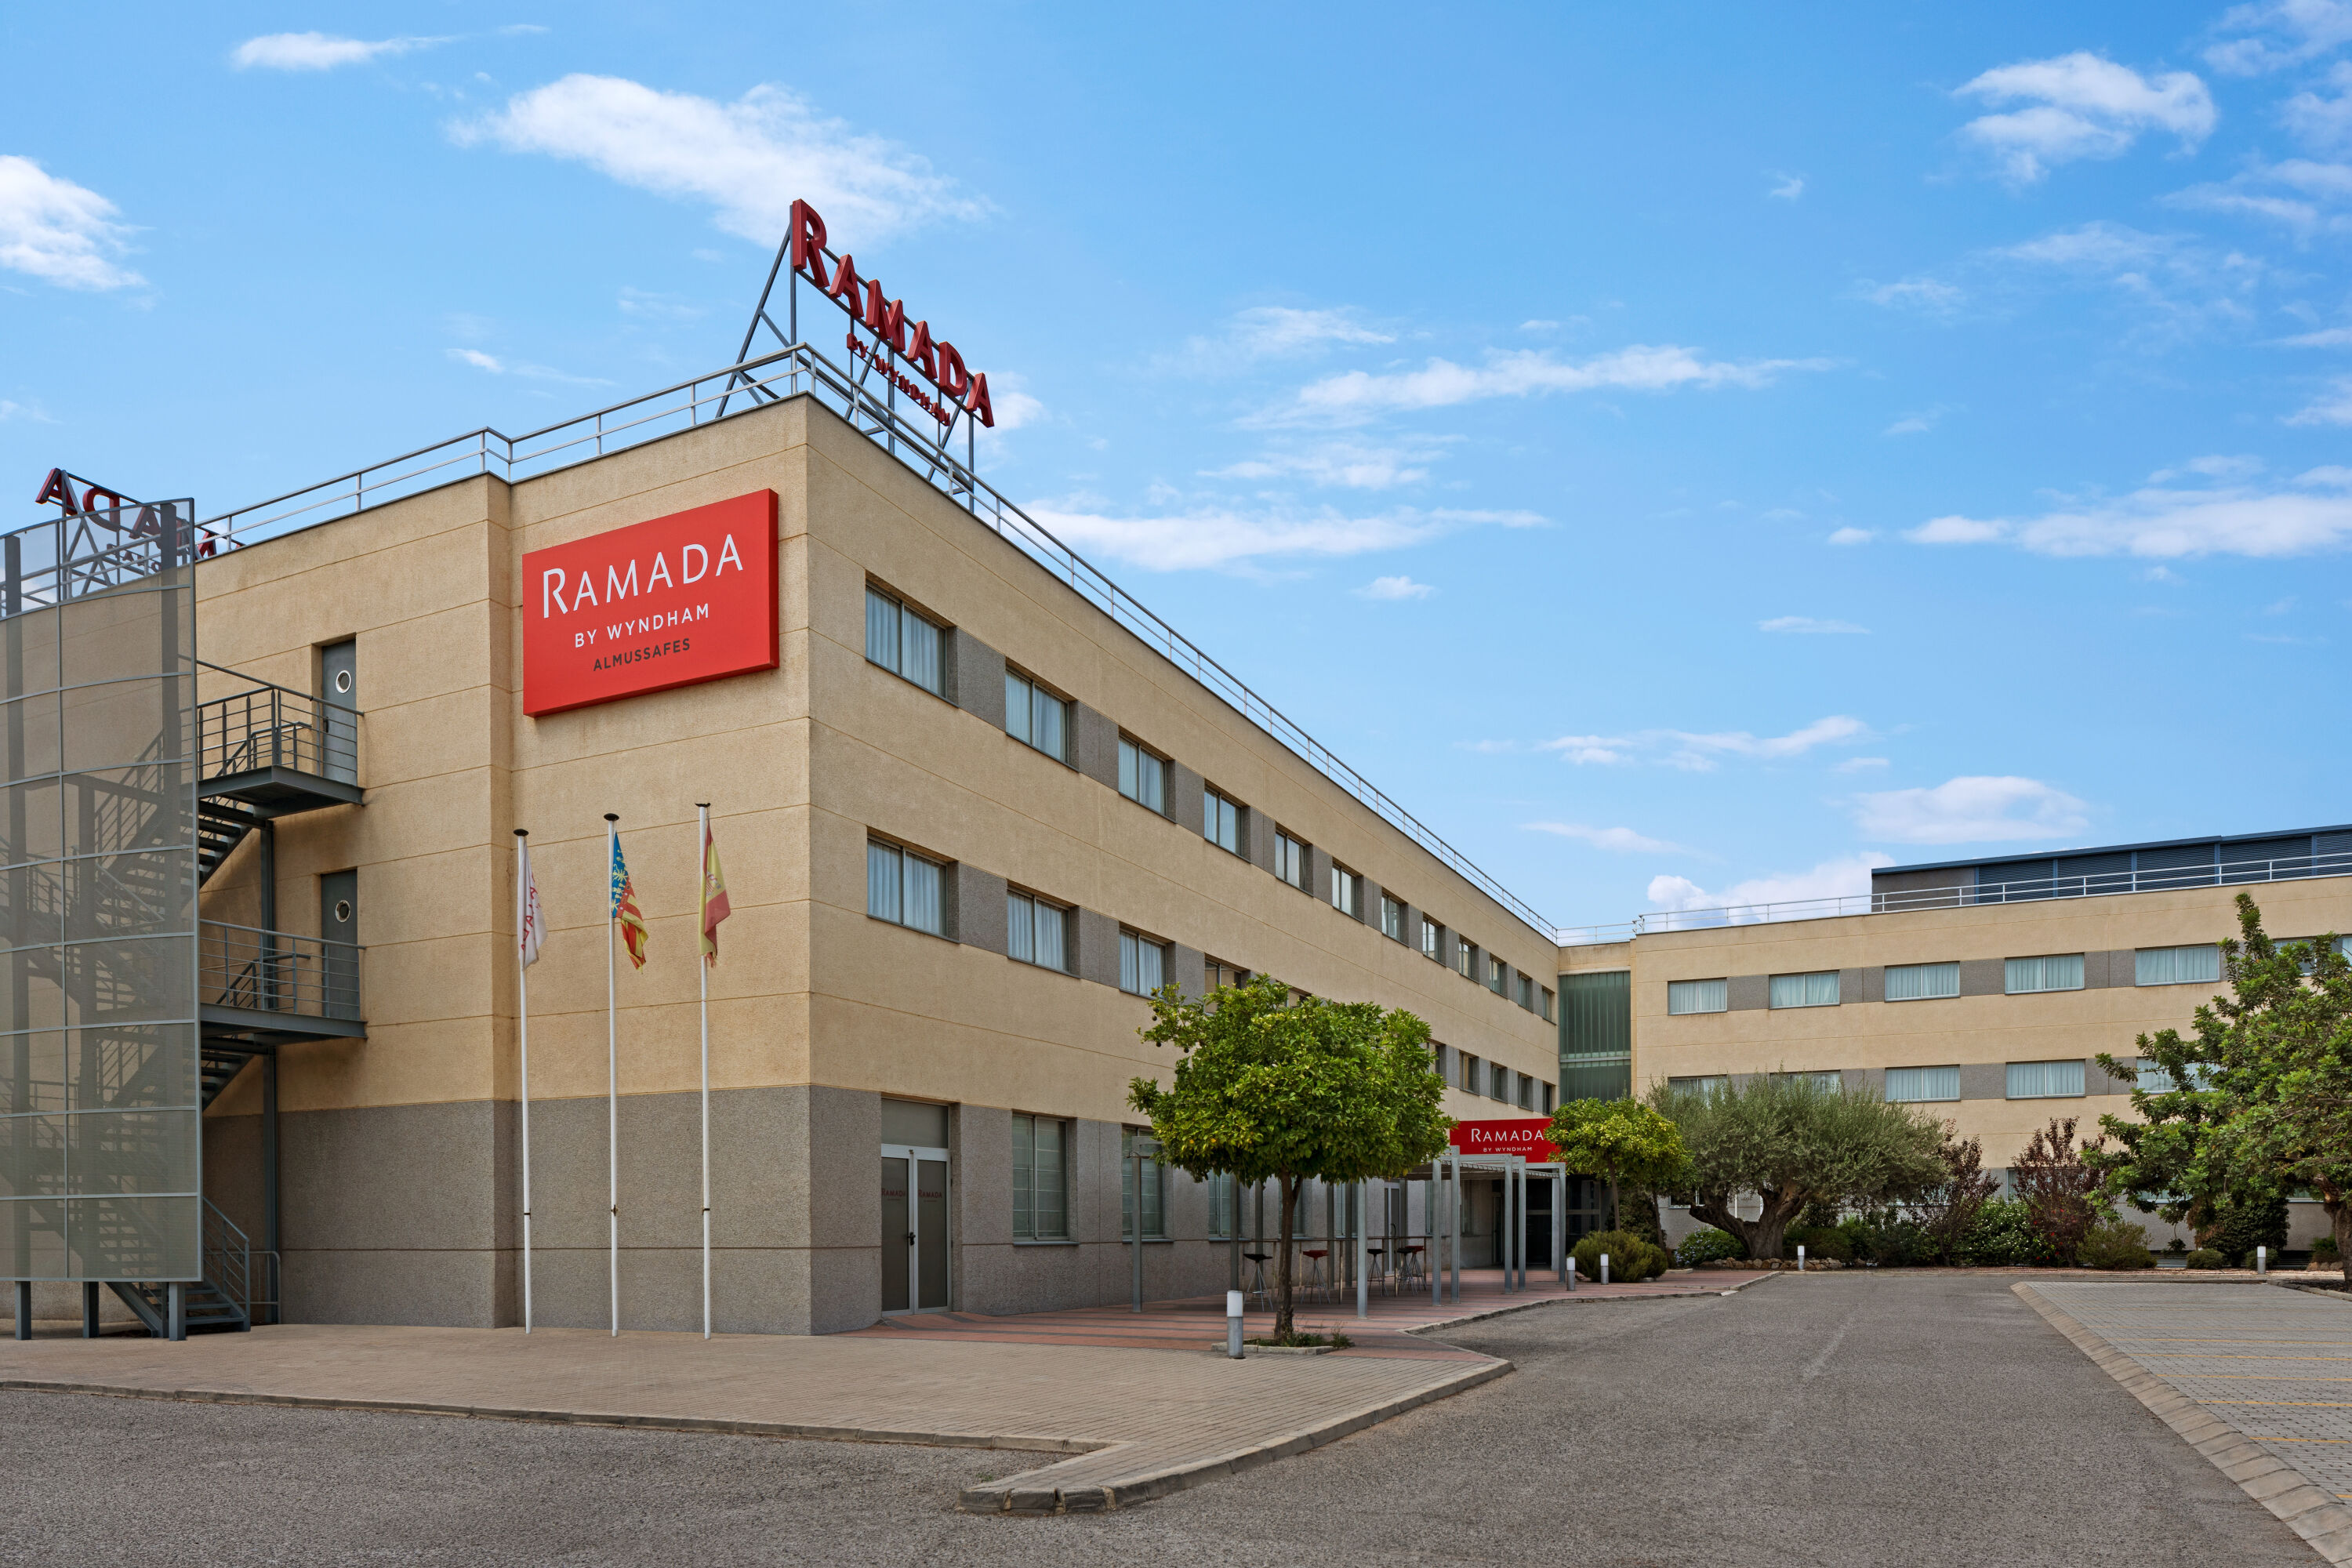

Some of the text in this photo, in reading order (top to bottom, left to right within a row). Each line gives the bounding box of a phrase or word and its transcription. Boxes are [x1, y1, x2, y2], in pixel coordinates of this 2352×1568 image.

[792, 198, 995, 428] RAMADA
[846, 332, 951, 426] BY WYNDHAM
[543, 533, 743, 619] RAMADA
[575, 603, 710, 648] BY WYNDHAM
[593, 637, 691, 672] ALMUSSAFES
[1471, 1127, 1544, 1142] RAMADA
